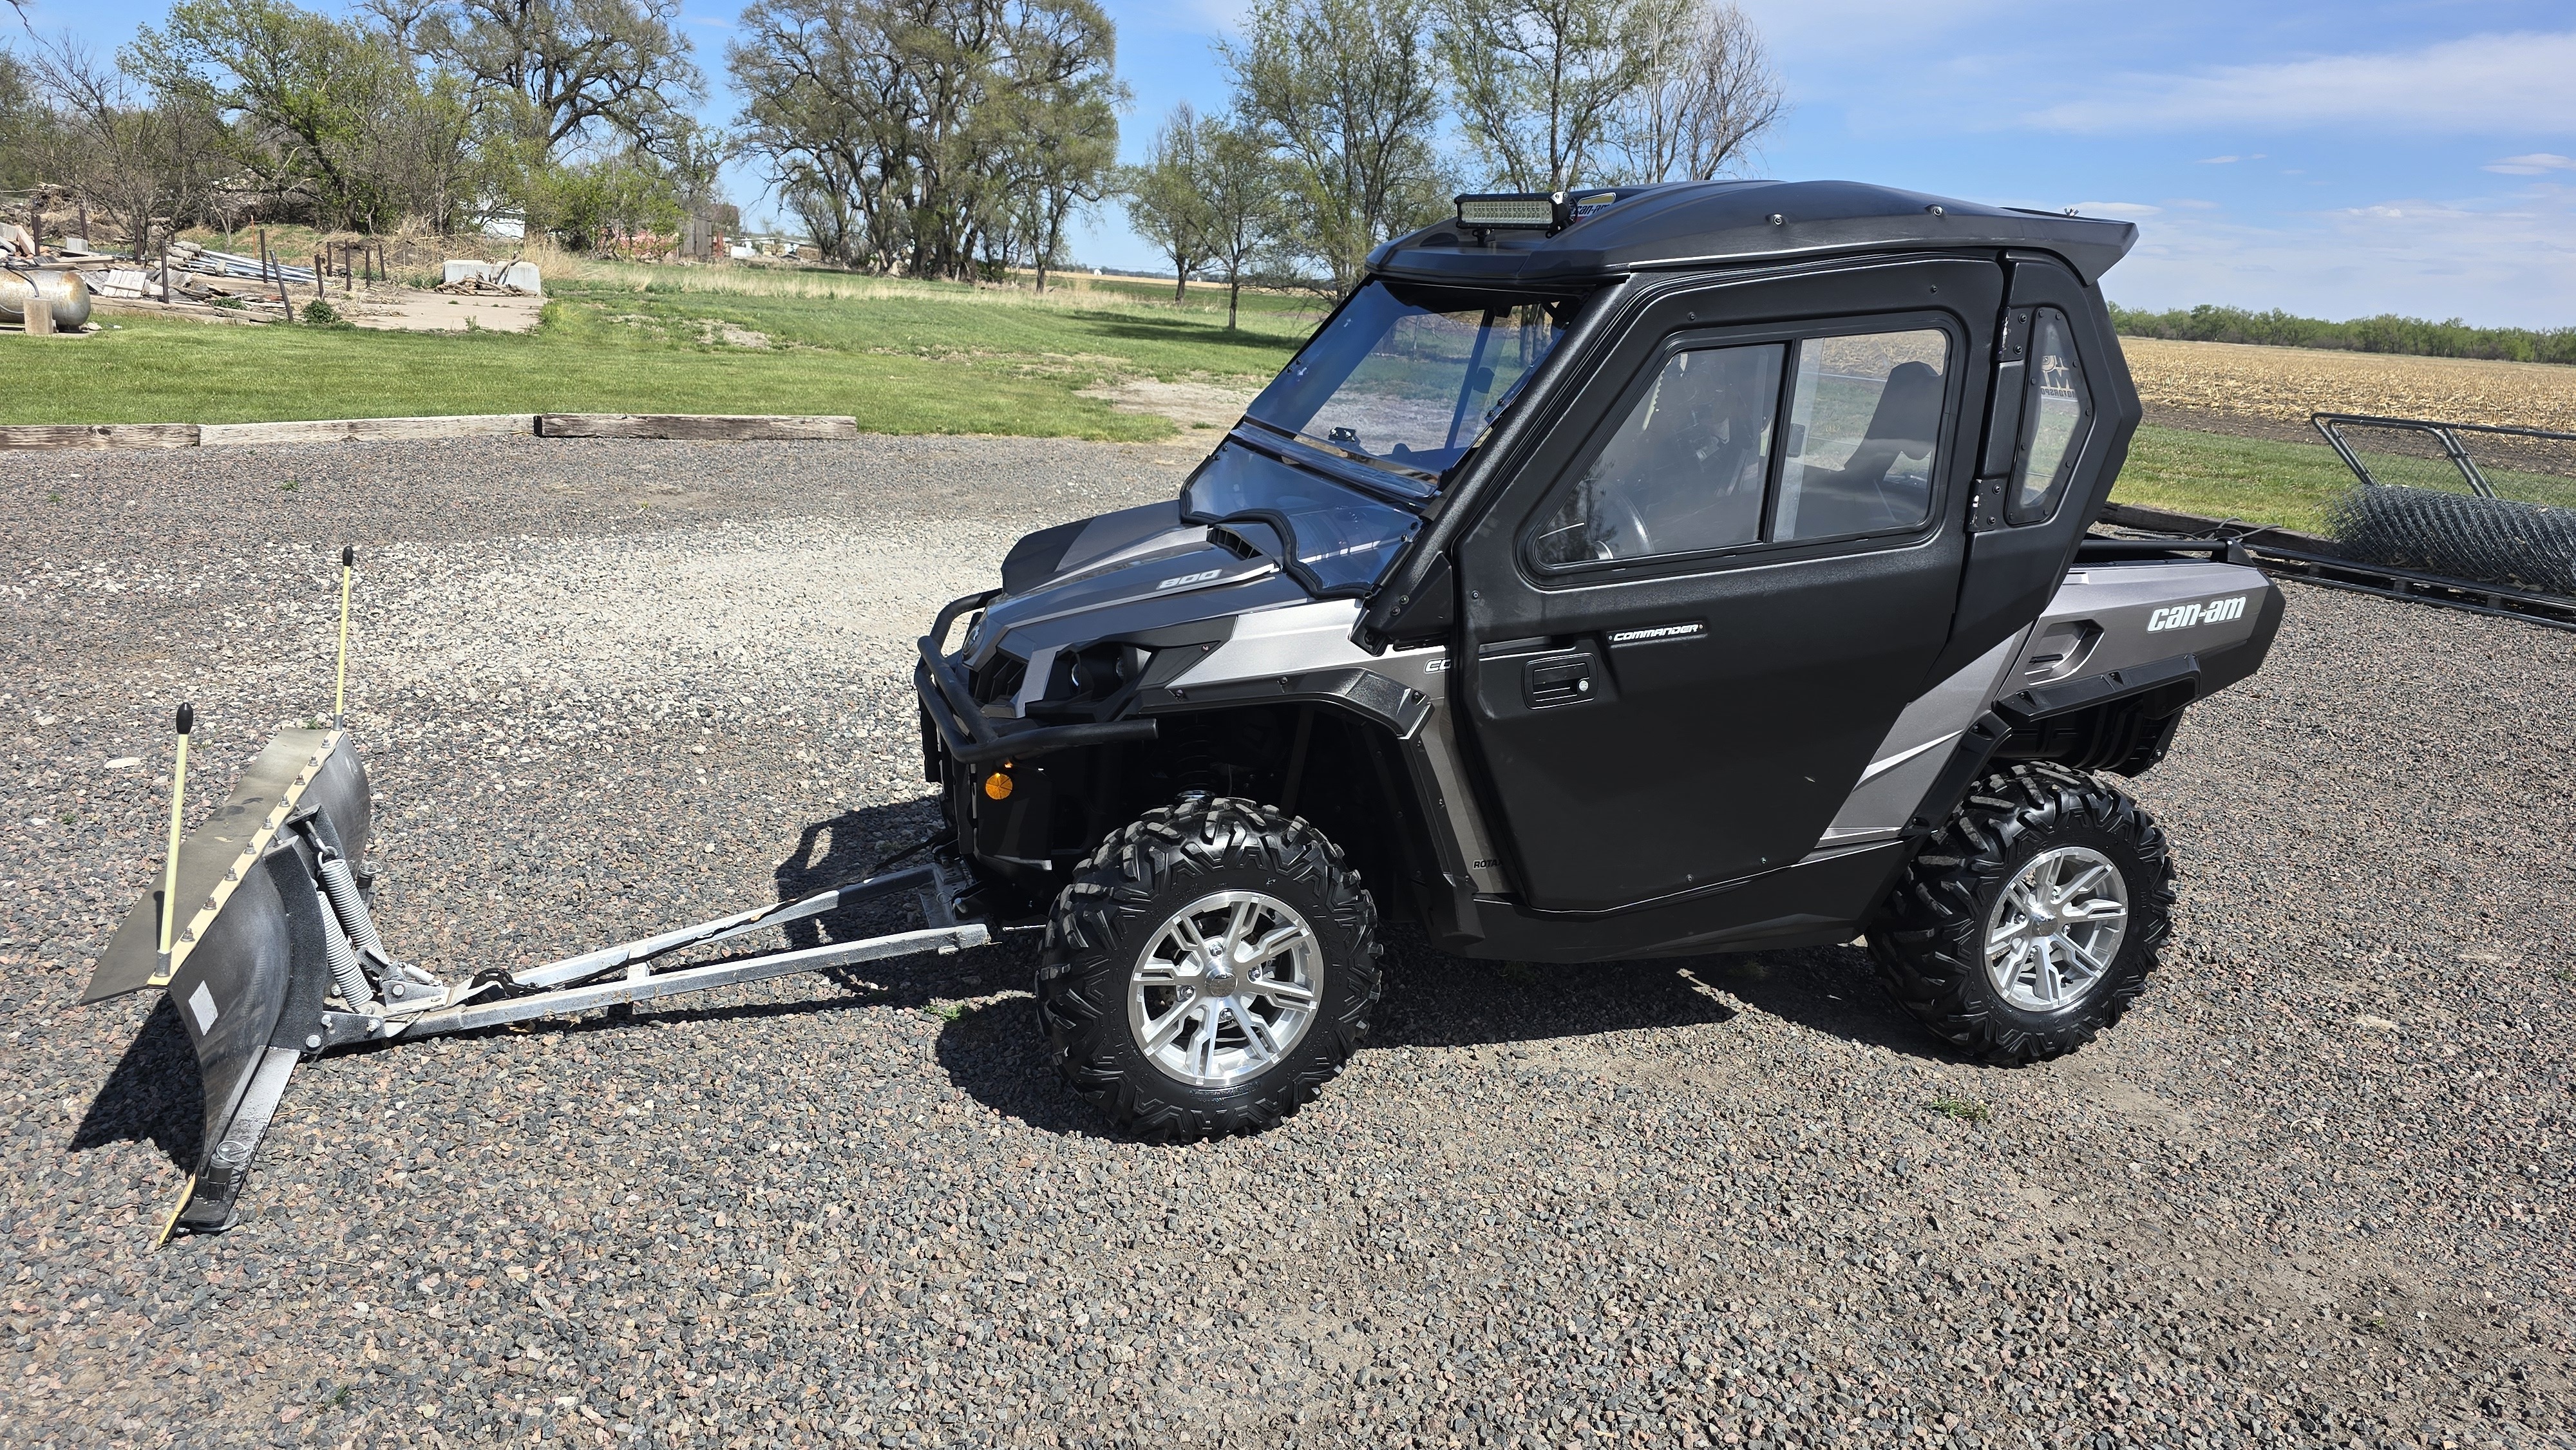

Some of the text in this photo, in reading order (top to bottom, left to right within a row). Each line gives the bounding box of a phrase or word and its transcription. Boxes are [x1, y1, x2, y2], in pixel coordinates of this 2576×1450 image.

[1157, 569, 1222, 589] 800
[2147, 596, 2247, 632] can-am
[1613, 624, 1699, 641] COMMANDER
